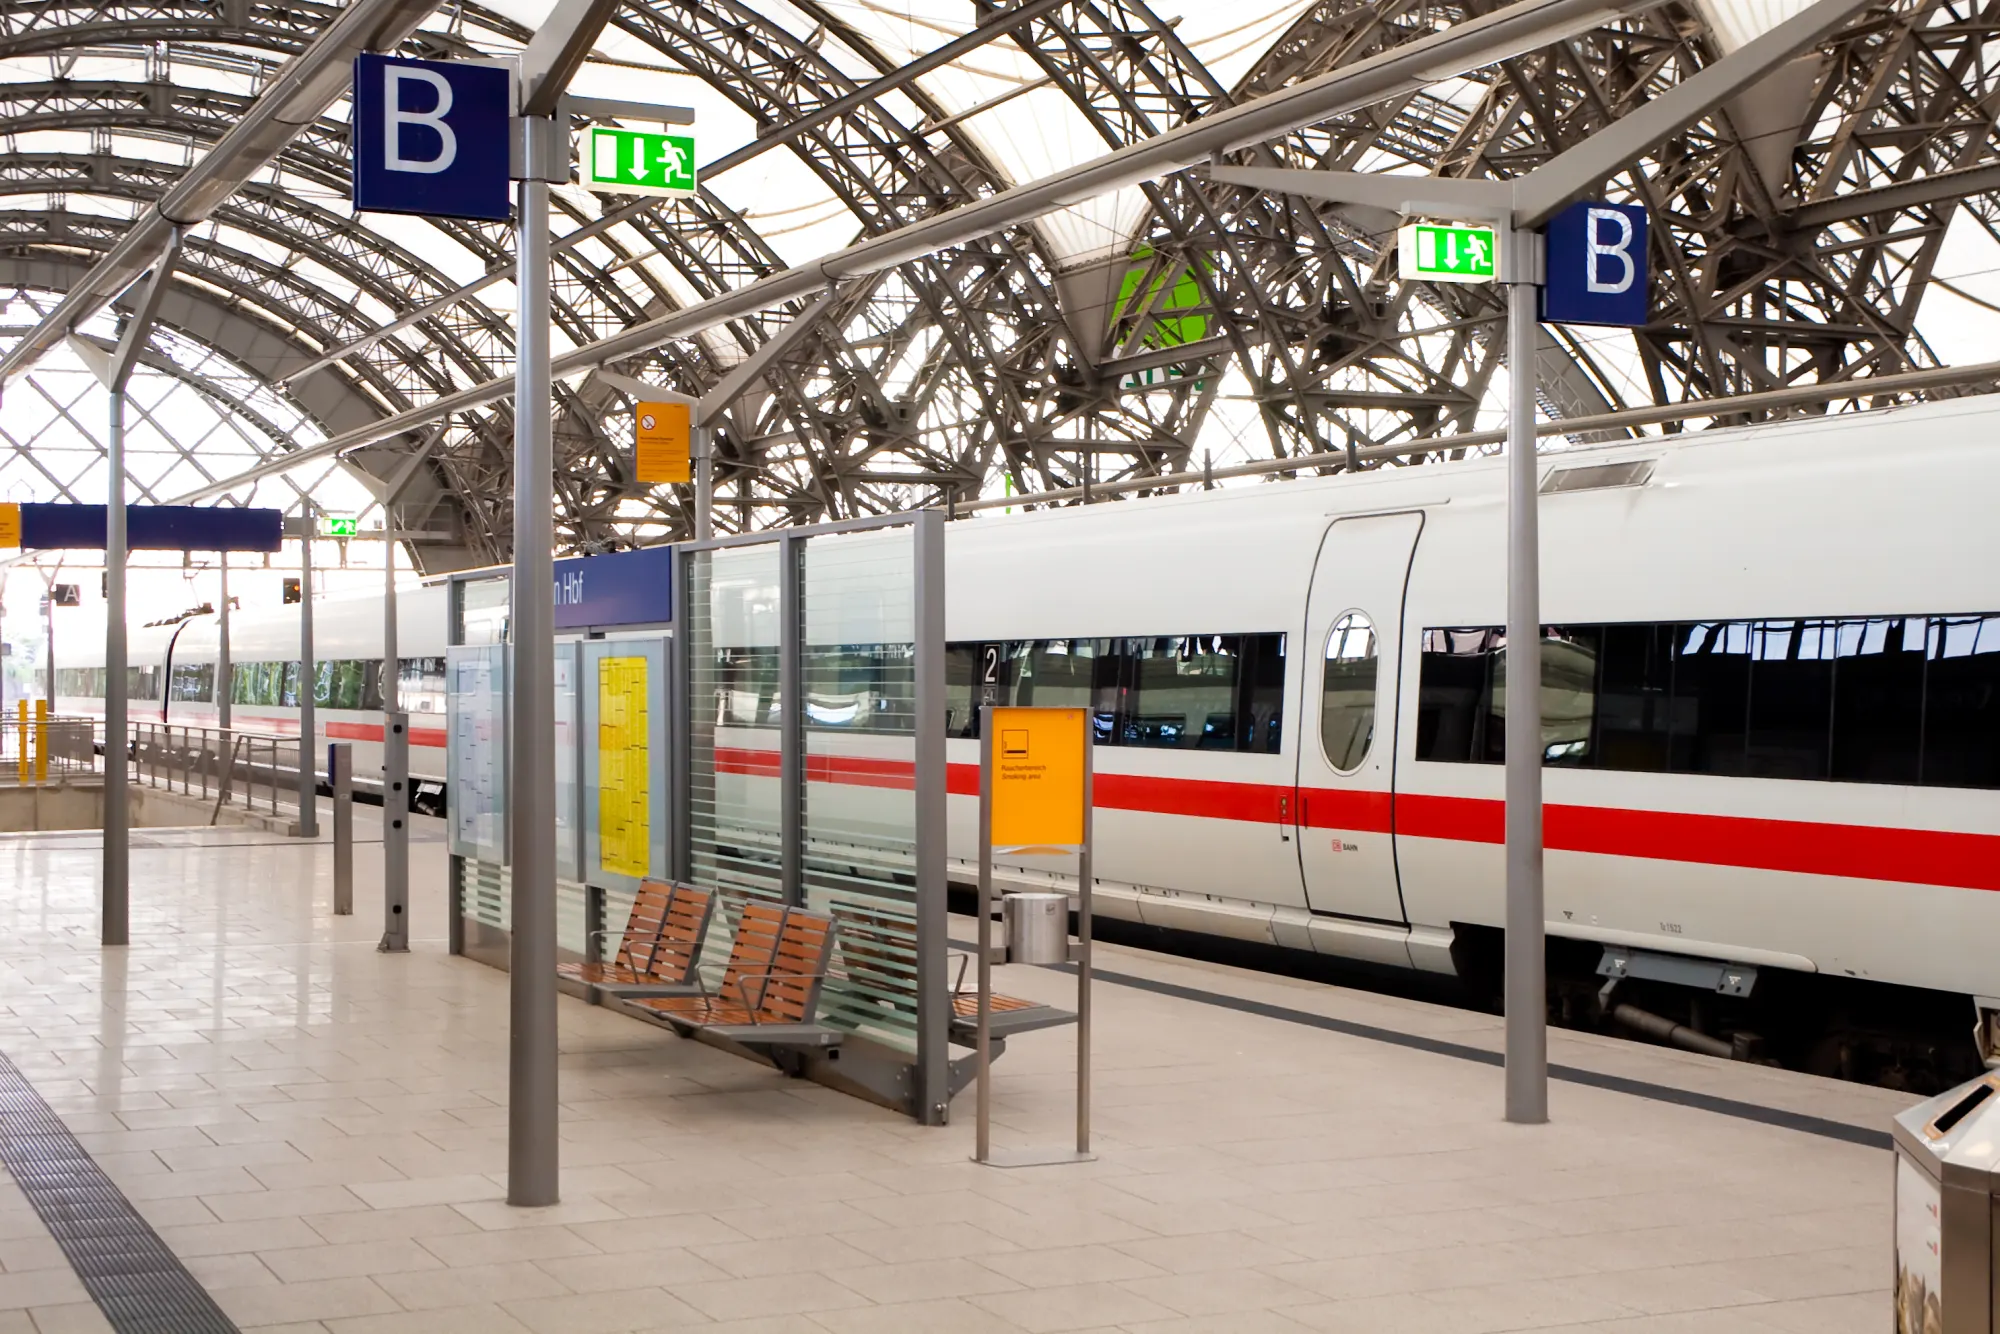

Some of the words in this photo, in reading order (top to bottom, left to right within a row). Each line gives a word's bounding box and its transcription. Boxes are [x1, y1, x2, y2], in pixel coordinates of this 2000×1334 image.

[384, 64, 457, 174] B
[1587, 208, 1635, 294] B
[64, 585, 79, 602] A
[563, 570, 584, 605] Hbf
[985, 648, 997, 682] 2
[1343, 843, 1358, 851] BAHN
